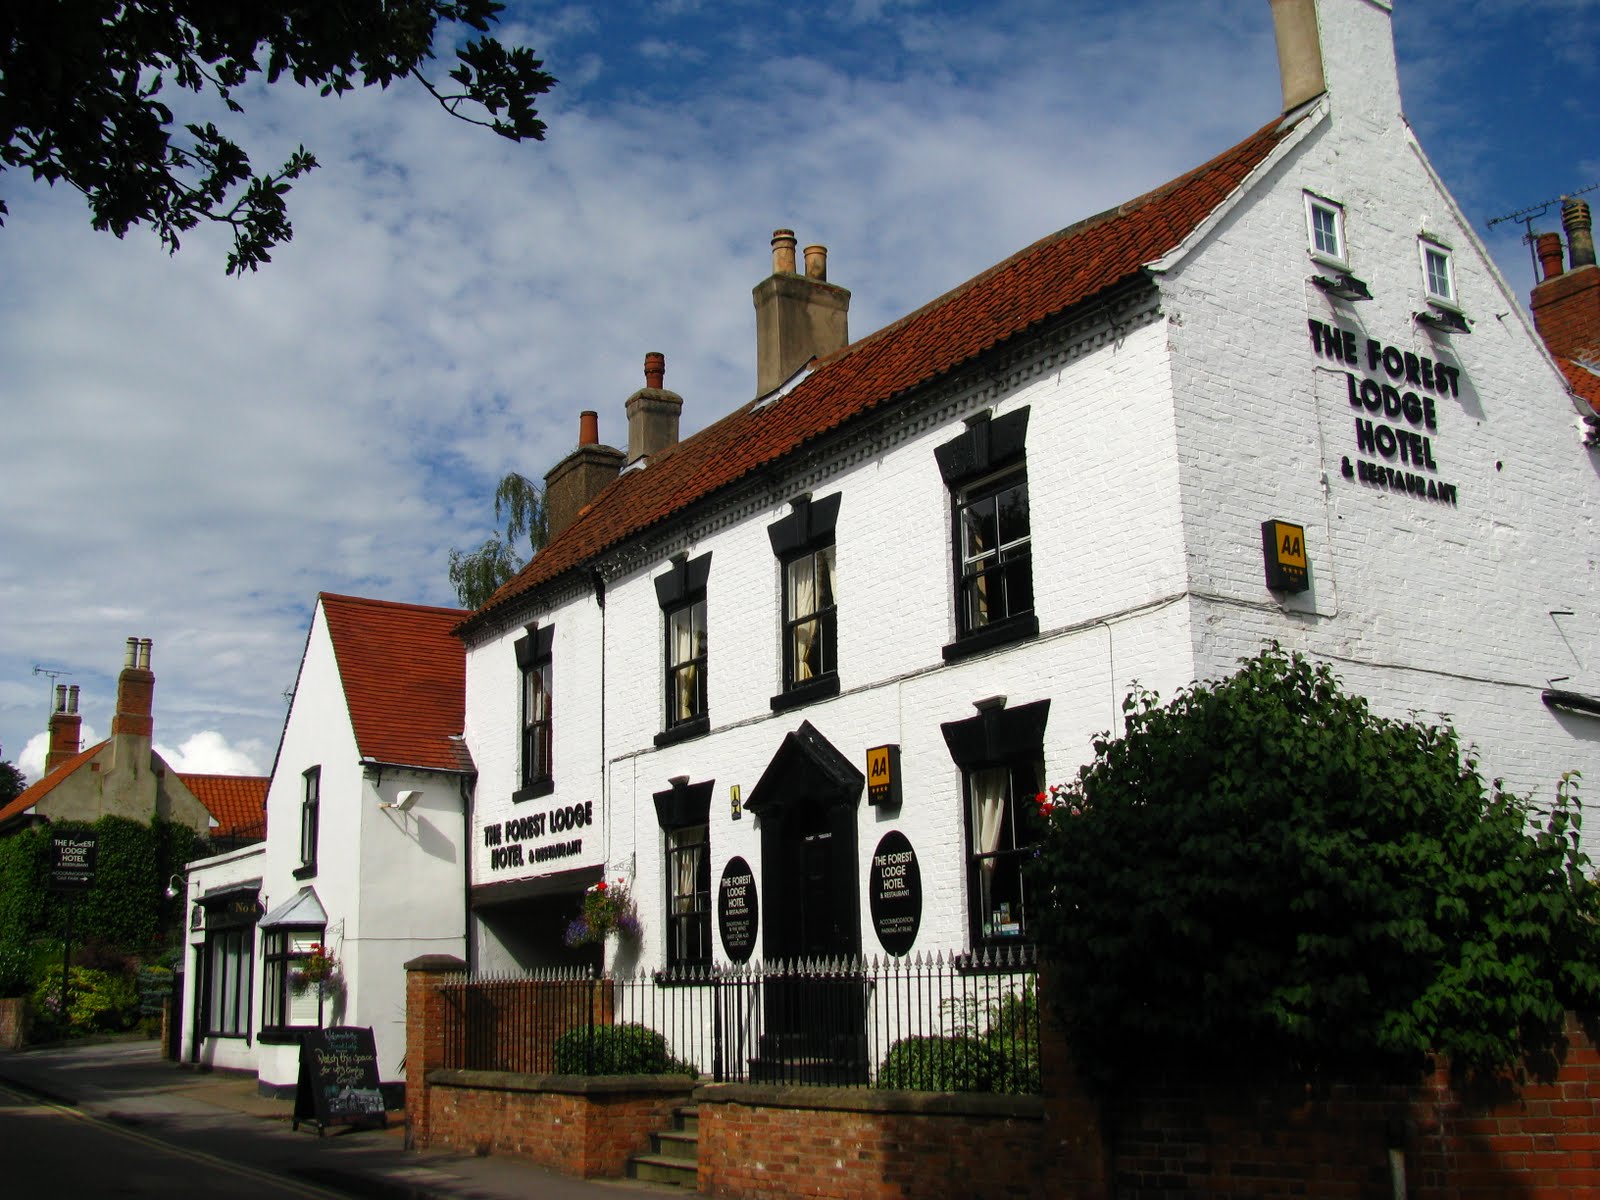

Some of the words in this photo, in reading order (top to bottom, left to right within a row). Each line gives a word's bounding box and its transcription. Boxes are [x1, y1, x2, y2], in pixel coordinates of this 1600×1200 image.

[1308, 318, 1358, 365] THE
[1367, 339, 1460, 398] FOREST
[1347, 372, 1437, 430] LODGE
[1356, 417, 1437, 470] HOTEL
[1341, 455, 1354, 478] &
[1357, 459, 1457, 504] RESTAURANT
[1281, 534, 1301, 557] AA
[872, 757, 886, 777] AA
[484, 823, 502, 847] THE
[505, 812, 546, 843] FOREST
[549, 800, 593, 833] LODGE
[61, 847, 87, 855] LODGE
[491, 844, 524, 871] HOTEL
[535, 839, 582, 863] RESTAURANT
[875, 855, 887, 866] THE
[888, 851, 912, 865] FOREST
[881, 865, 906, 878] LODGE
[722, 878, 731, 887] THE
[732, 875, 751, 885] FOREST
[883, 878, 905, 890] HOTEL
[727, 887, 746, 897] LODGE
[884, 889, 910, 899] RESTAURANT
[251, 903, 256, 913] 4
[728, 898, 745, 908] HOTEL
